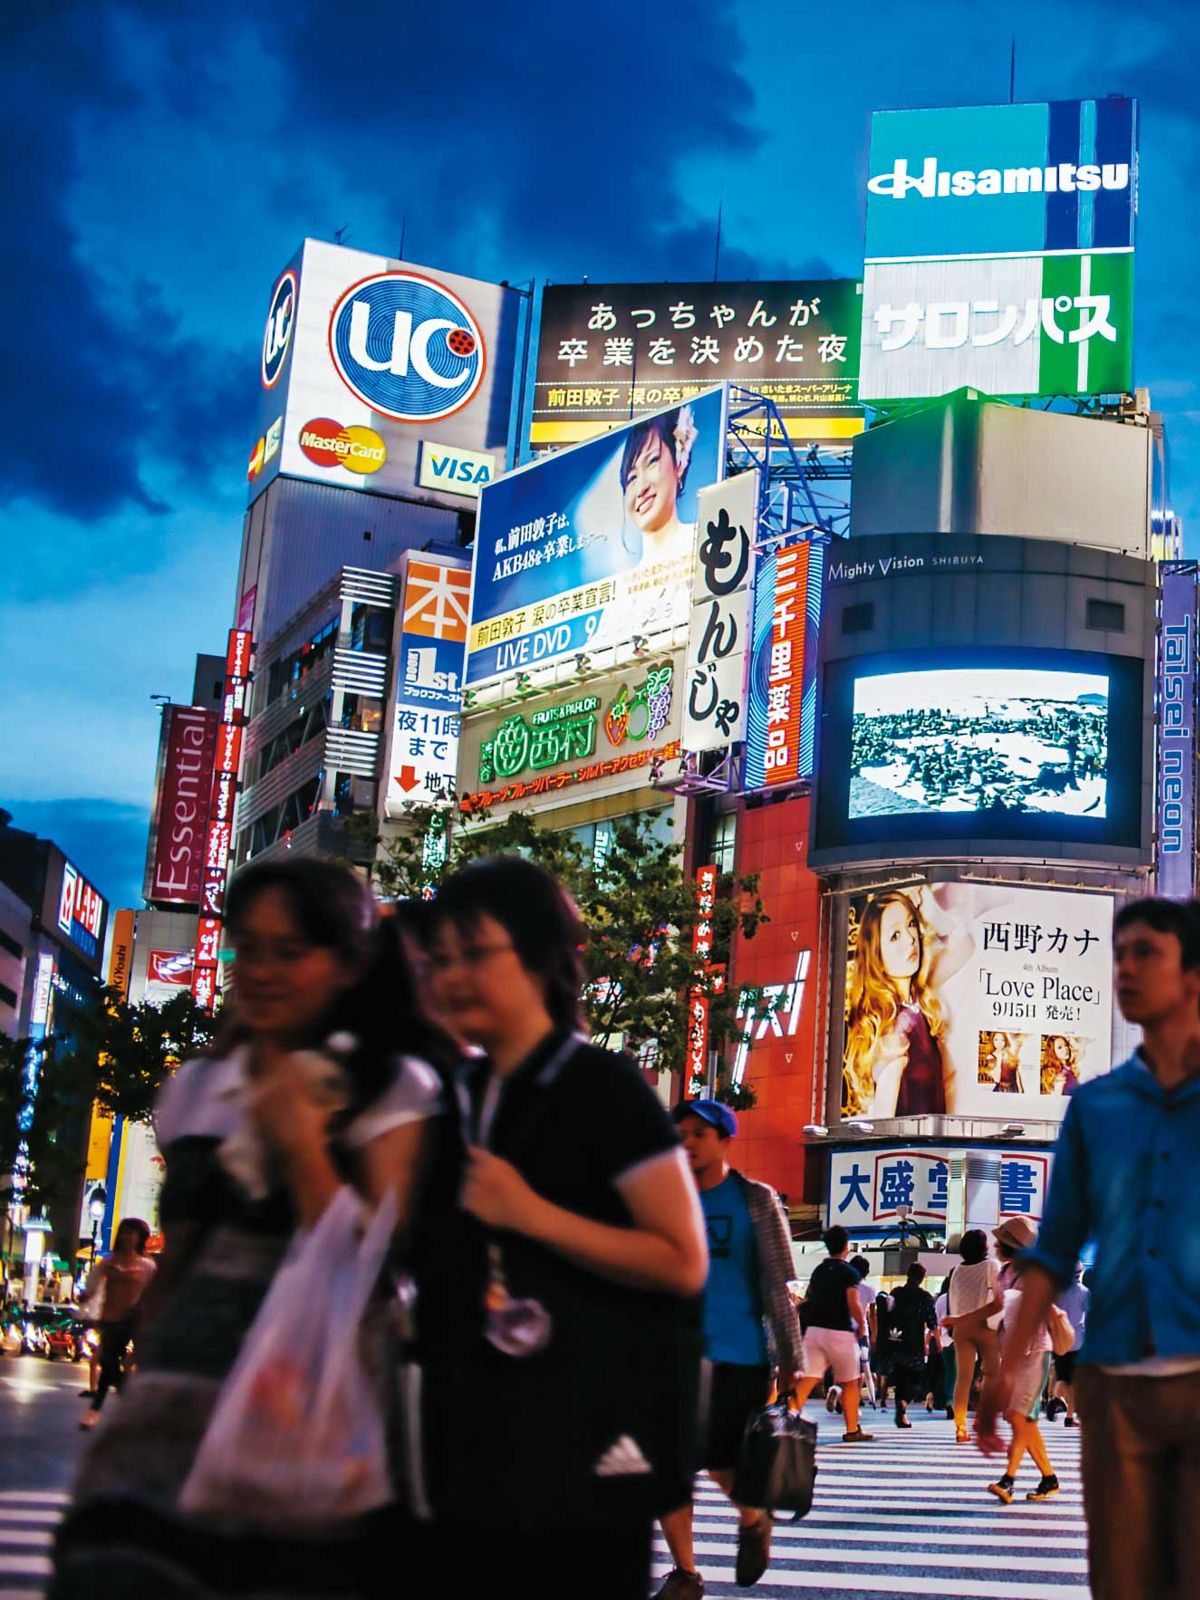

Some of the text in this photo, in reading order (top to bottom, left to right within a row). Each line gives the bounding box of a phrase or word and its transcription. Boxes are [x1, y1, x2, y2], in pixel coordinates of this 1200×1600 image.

[867, 157, 1129, 199] Hisamitsu
[587, 296, 822, 331] あっちゃんが
[874, 295, 1117, 351] サロンパス
[557, 334, 848, 367] 卒業を決めた夜
[547, 388, 621, 407] 前田敦子
[300, 430, 385, 462] MasterCard
[431, 455, 490, 484] VISA
[828, 555, 985, 581] Mighty Vision SHIBUYA
[475, 612, 526, 646] 前田敦子
[688, 508, 750, 738] もんじゃ
[496, 645, 530, 671] LIVE
[533, 624, 571, 660] DVD
[763, 552, 801, 768] 三千里薬品
[398, 710, 460, 737] 夜11時
[1162, 614, 1190, 854] Taisei neon
[409, 737, 448, 760] まで
[156, 714, 206, 894] Essential
[982, 921, 1100, 957] 西野カナ
[993, 1002, 1081, 1021] 9月5日 発売!
